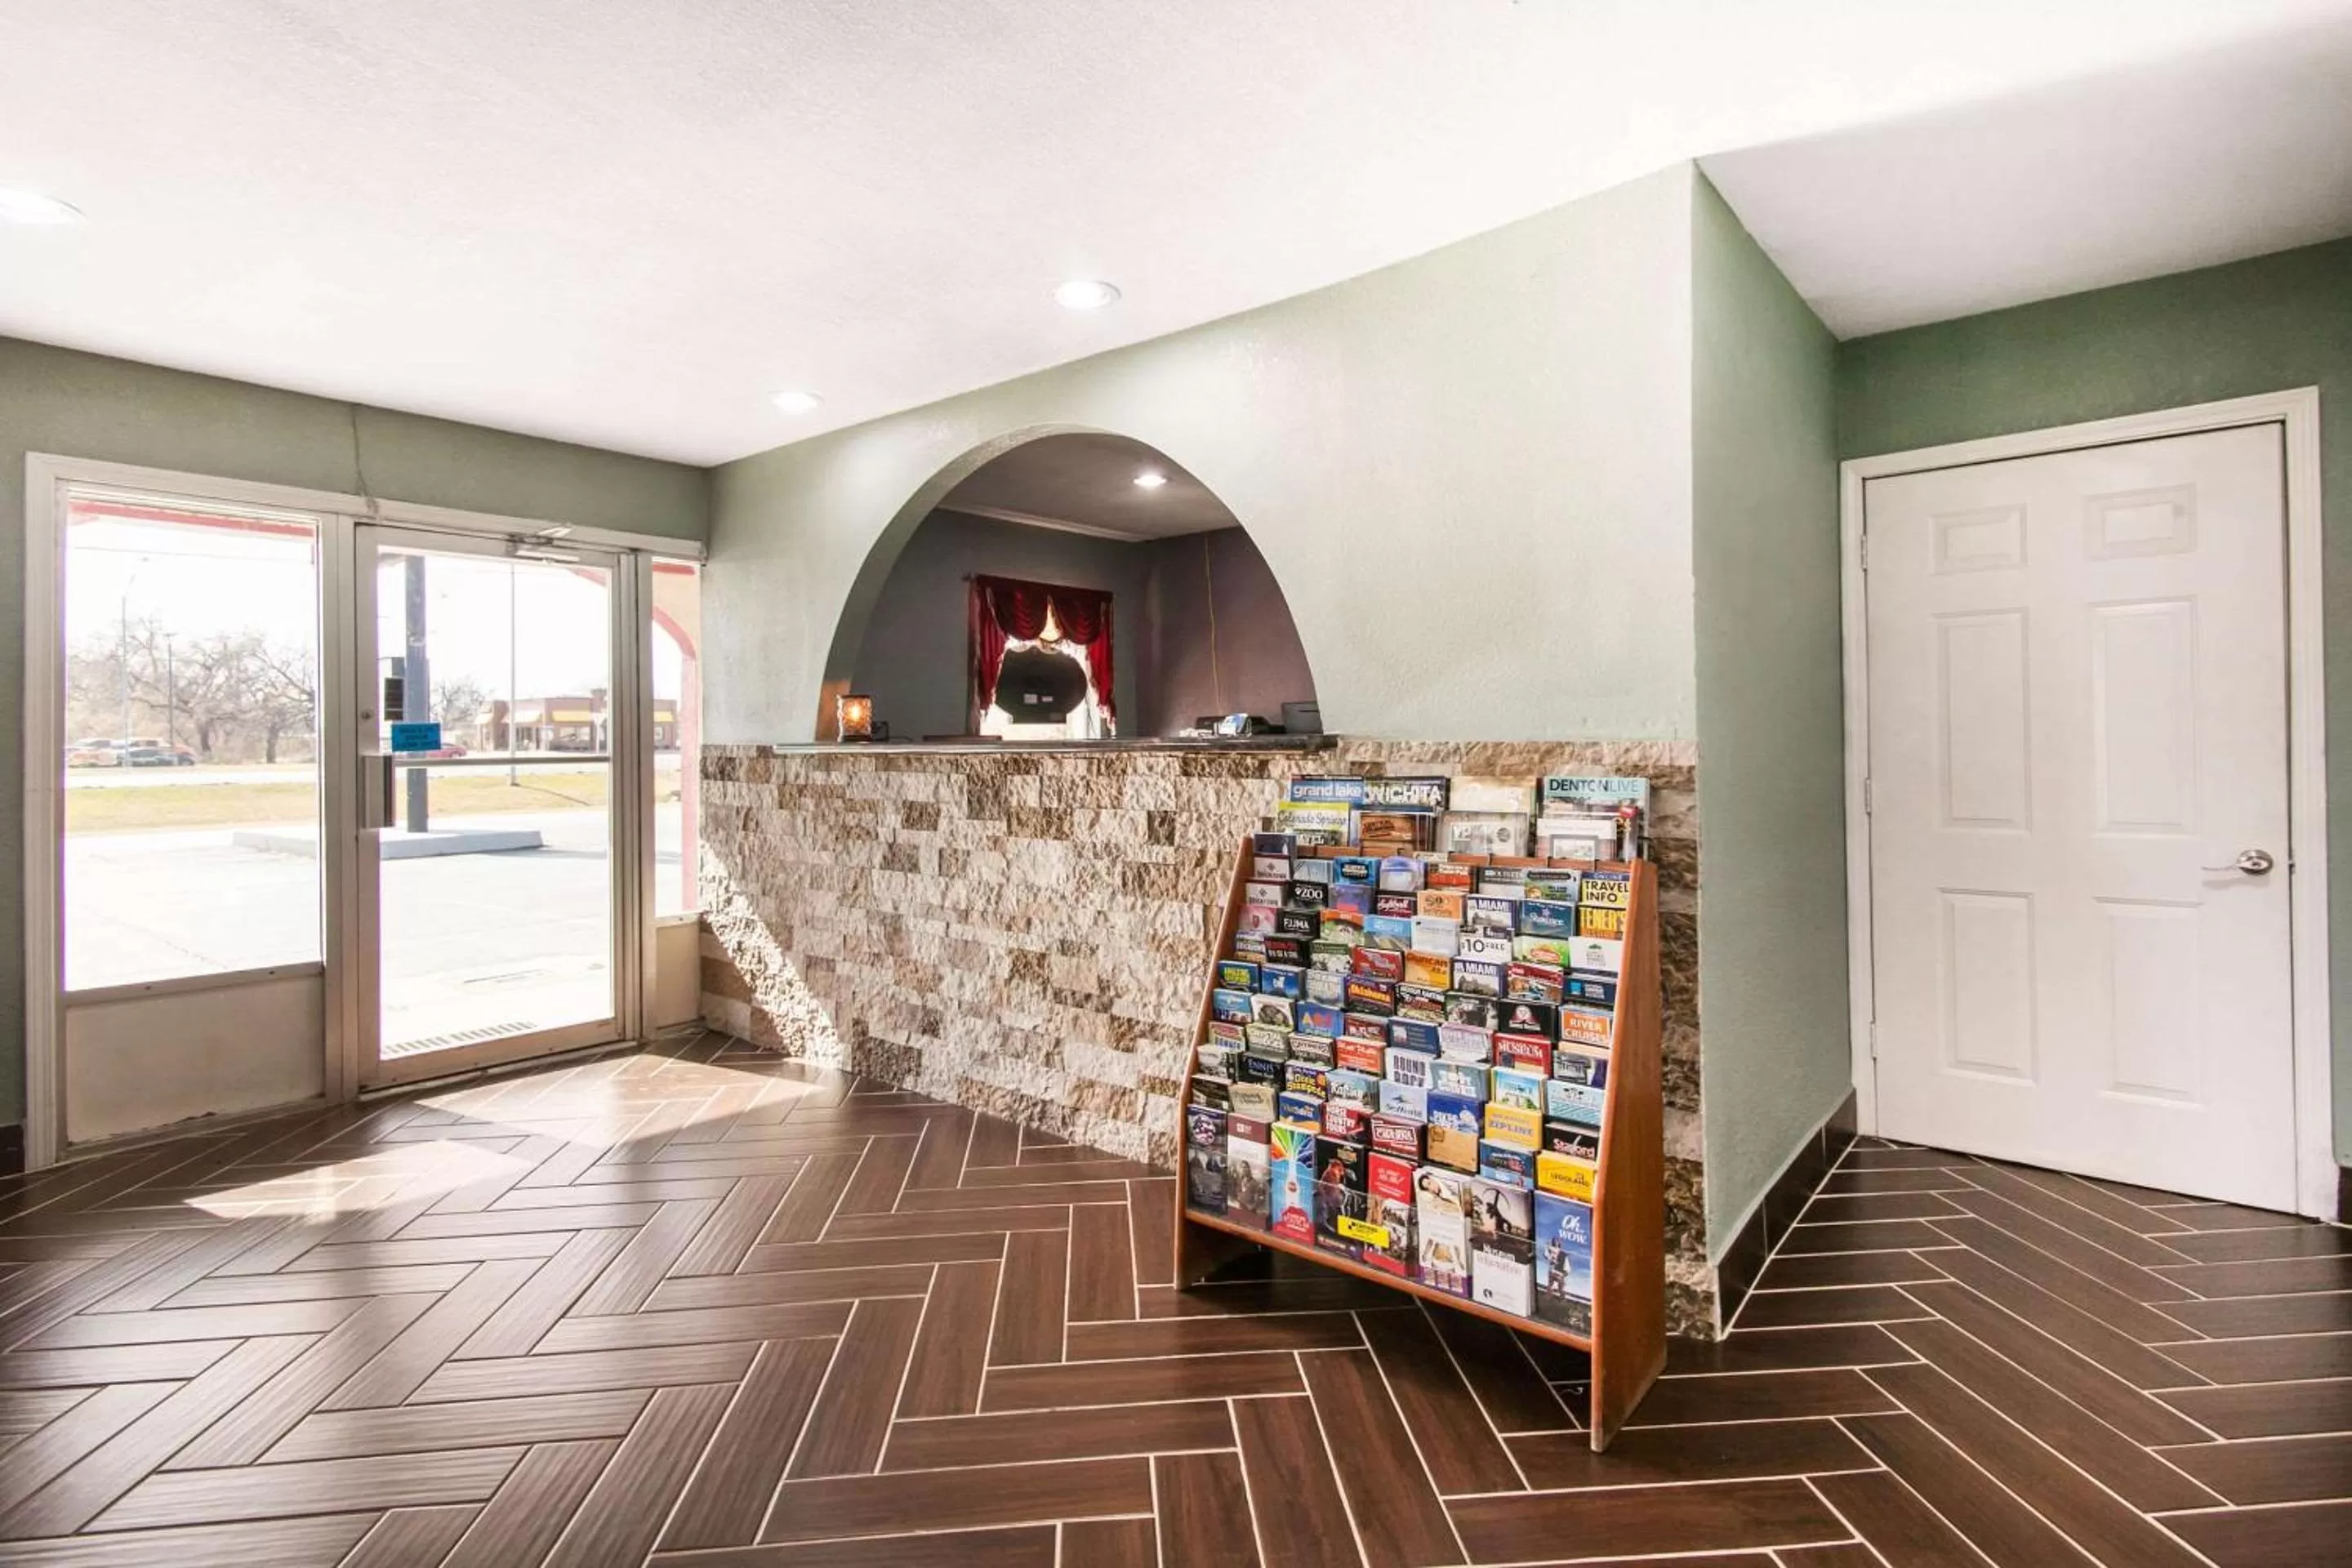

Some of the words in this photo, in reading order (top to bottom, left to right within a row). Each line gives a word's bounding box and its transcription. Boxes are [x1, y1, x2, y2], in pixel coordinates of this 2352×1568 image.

[1293, 784, 1334, 798] grand
[1335, 782, 1361, 797] lake
[1363, 783, 1442, 804] WICHITA
[1303, 887, 1323, 899] ZOO
[1585, 880, 1628, 893] TRAVEL
[1586, 892, 1618, 902] INFO
[1478, 899, 1509, 912] MIAMI
[1466, 963, 1498, 977] MIAMI
[1570, 1018, 1602, 1031] RIVER
[1498, 1041, 1543, 1058] MUSEUM
[1393, 1055, 1426, 1076] ROUND
